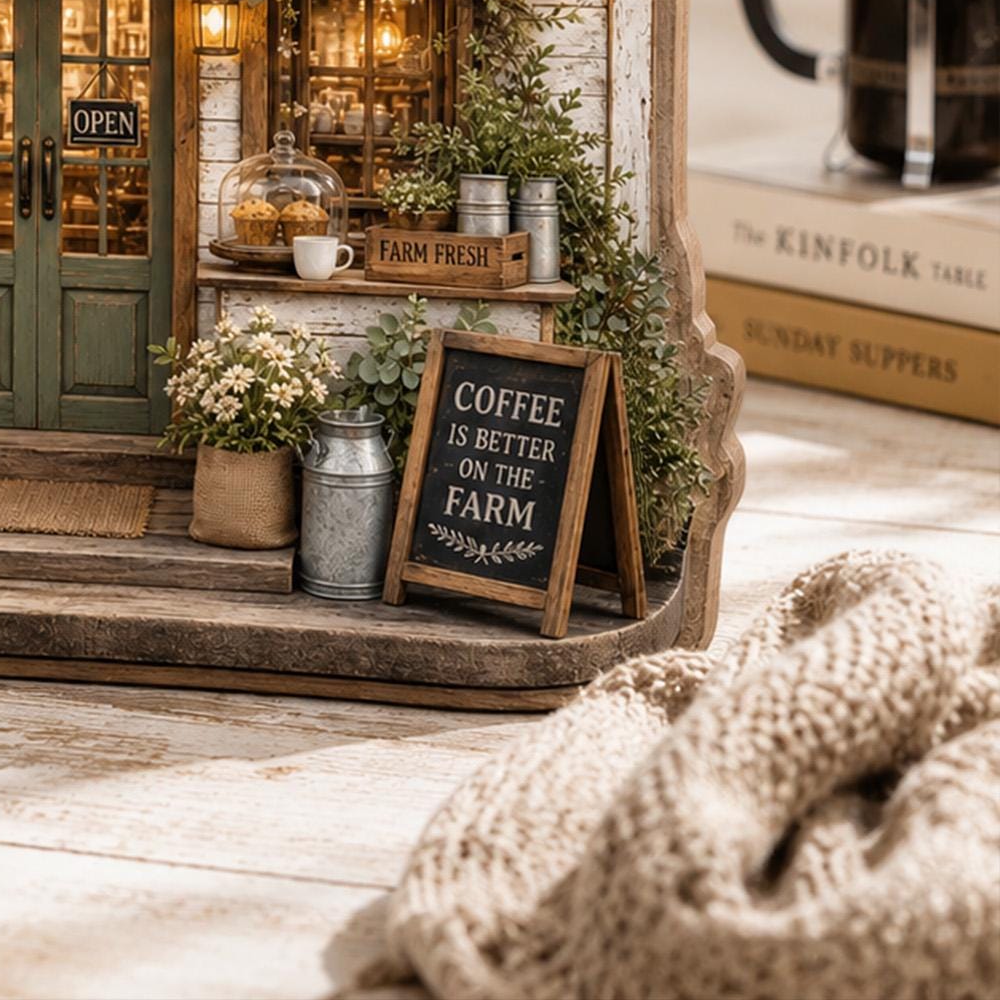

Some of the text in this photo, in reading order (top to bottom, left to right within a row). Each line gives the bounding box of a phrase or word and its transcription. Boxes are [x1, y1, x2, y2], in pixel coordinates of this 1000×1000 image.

[73, 109, 135, 135] OPEN
[380, 239, 489, 267] FARM FRESH
[775, 224, 920, 280] KINFOLK
[932, 261, 987, 290] TABLE
[743, 318, 958, 382] SUNDAY SUPPERS
[455, 381, 565, 428] COFFEE
[448, 423, 556, 463] IS BETTER
[459, 458, 535, 490] ON THE
[443, 485, 536, 531] FARM
